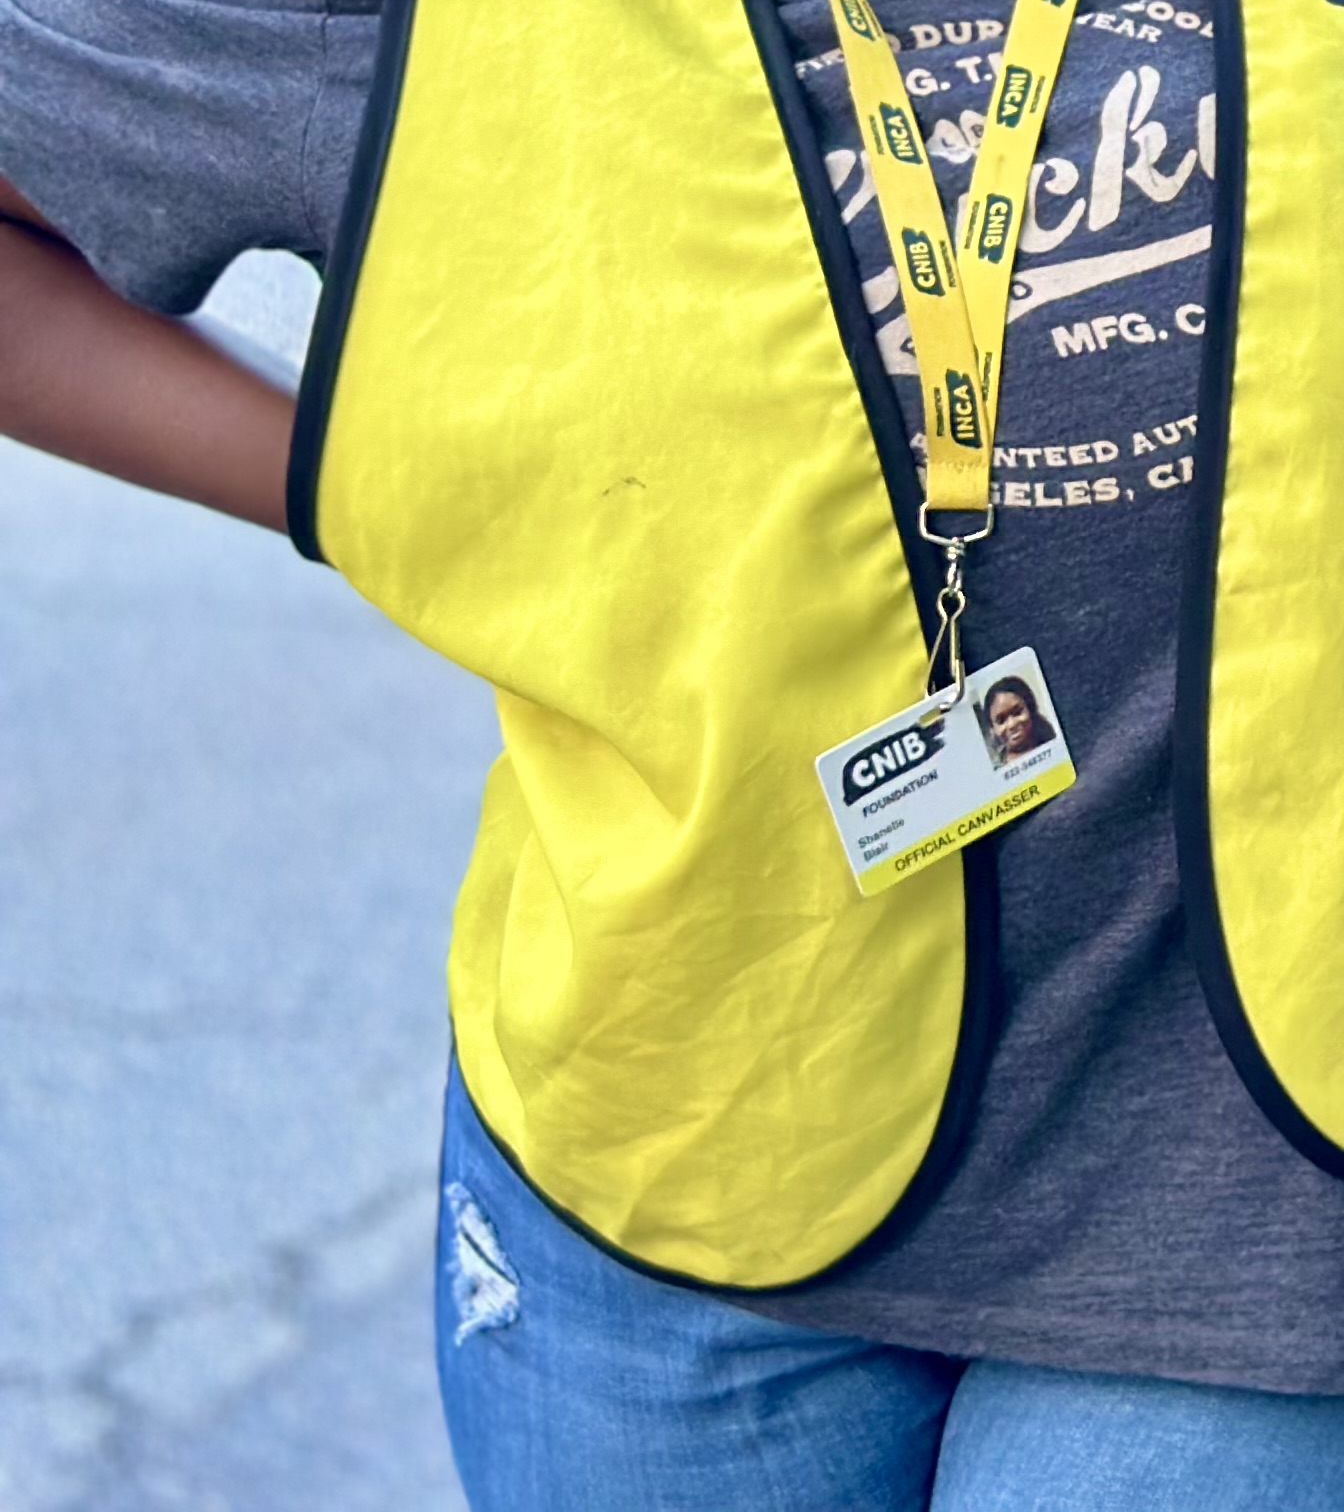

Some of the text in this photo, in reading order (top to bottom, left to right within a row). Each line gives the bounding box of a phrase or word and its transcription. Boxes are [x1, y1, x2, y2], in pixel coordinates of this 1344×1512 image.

[1001, 73, 1028, 116] INCA
[888, 115, 915, 158] INCA
[984, 201, 1009, 248] CNIB
[909, 241, 936, 288] CNIB
[1051, 303, 1206, 358] MFG. C
[953, 384, 975, 439] INCA
[994, 415, 1198, 470] NTEED AUT
[992, 477, 1134, 507] ELES,
[852, 731, 927, 788] CNIB
[863, 769, 938, 818] FOUNDATION
[894, 784, 1041, 873] OFFICIAL CANVASSER
